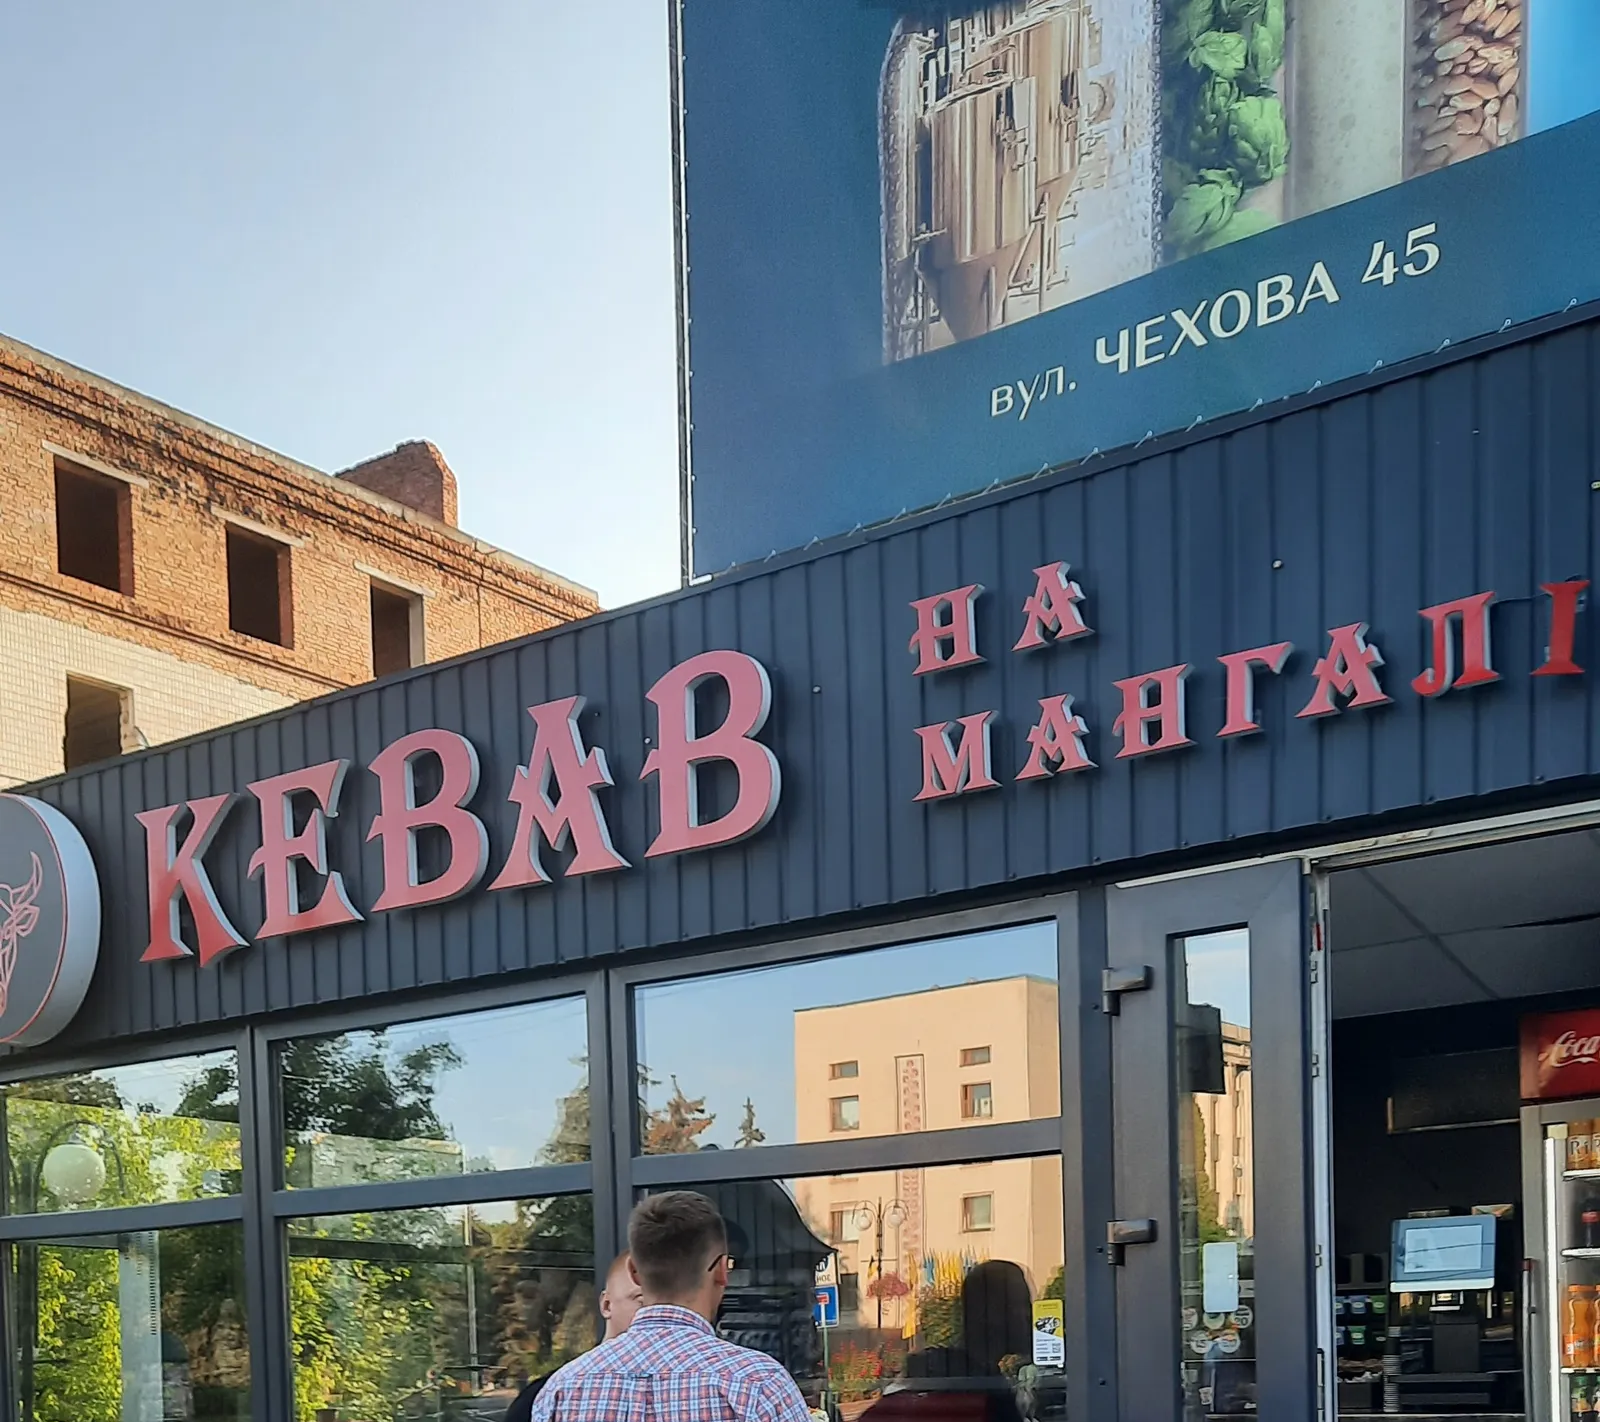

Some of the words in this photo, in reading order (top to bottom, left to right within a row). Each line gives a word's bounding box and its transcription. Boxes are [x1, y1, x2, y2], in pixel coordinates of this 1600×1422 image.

[989, 364, 1078, 420] вул.
[1095, 261, 1340, 375] ЧЕХОВА
[1360, 222, 1442, 286] 45
[908, 560, 1096, 677] НА
[911, 579, 1591, 802] МАНГАЛІ
[134, 648, 782, 968] KEBAB
